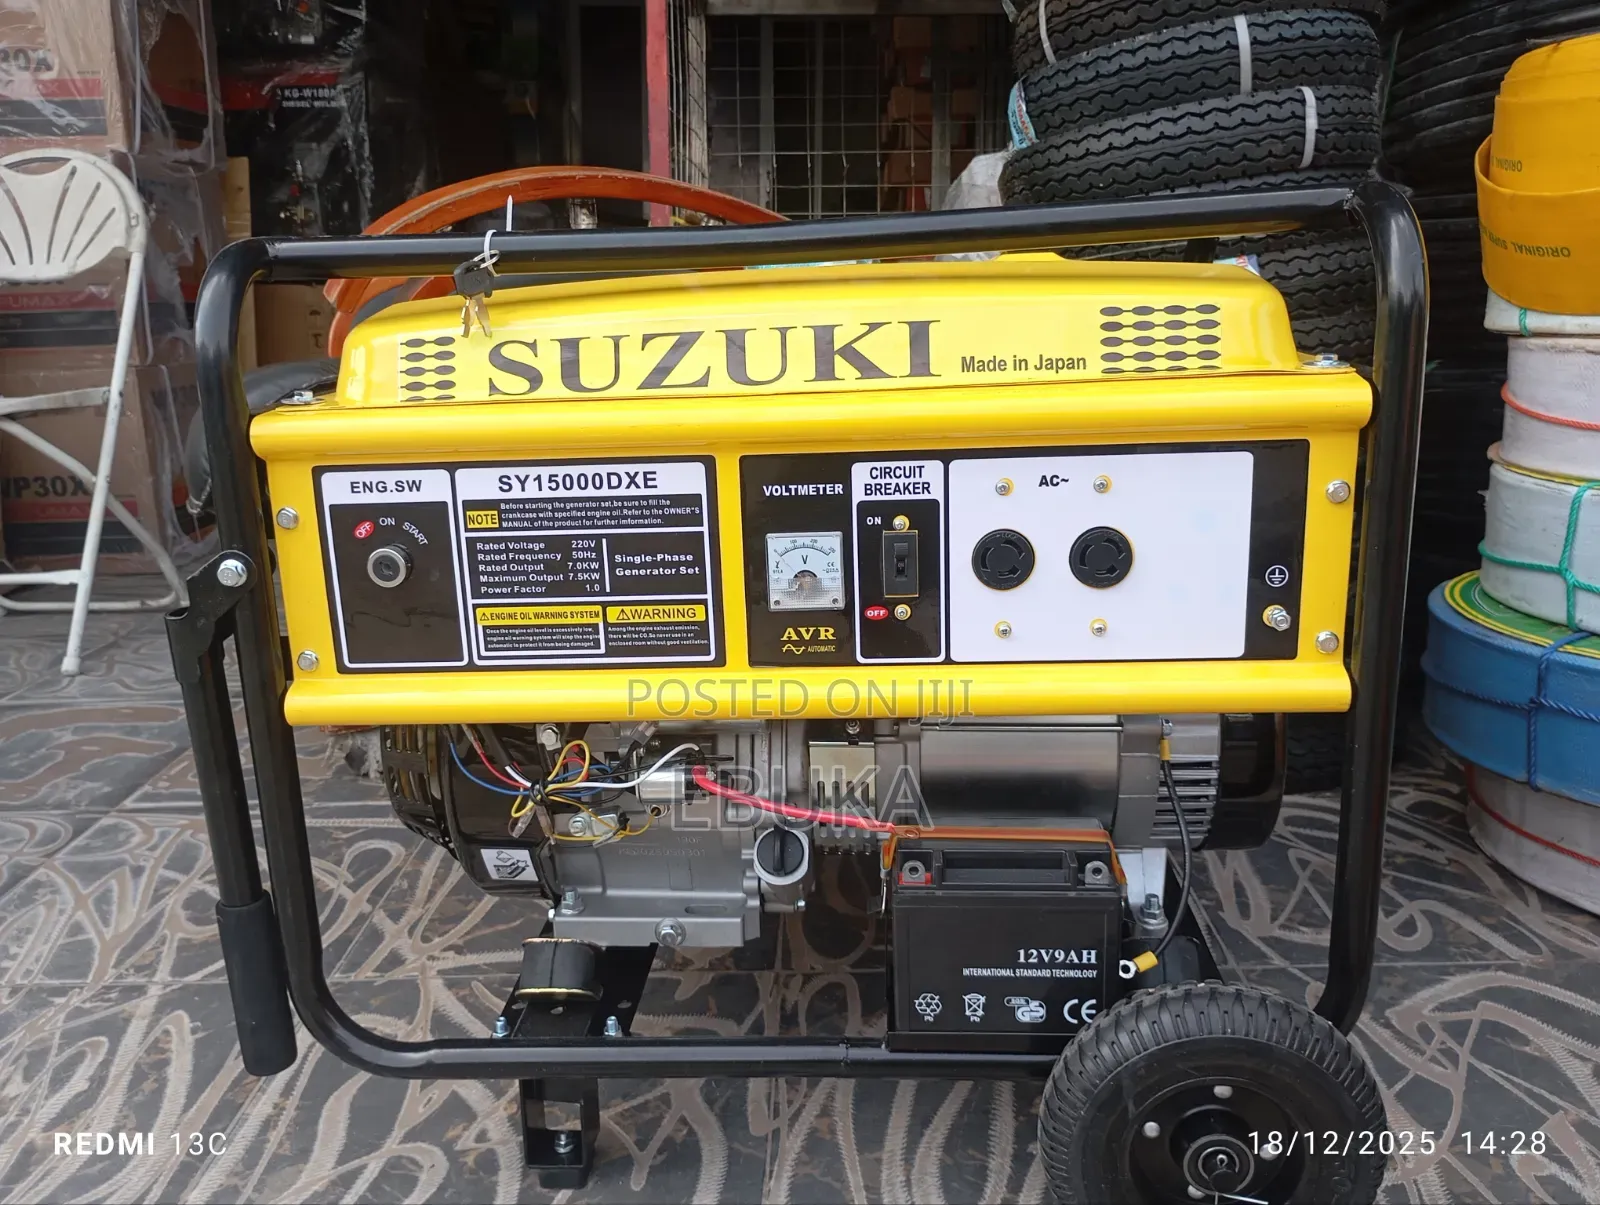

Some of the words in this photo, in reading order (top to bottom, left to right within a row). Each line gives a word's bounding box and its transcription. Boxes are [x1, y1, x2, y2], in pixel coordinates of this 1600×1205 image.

[1511, 242, 1571, 258] ORIGINAL
[488, 319, 942, 397] SUZUKI
[961, 355, 1008, 373] Made
[1012, 354, 1028, 372] in
[1034, 354, 1087, 374] Japan
[869, 465, 925, 480] CIRCUIT
[350, 480, 422, 494] ENG.SW
[498, 471, 658, 493] SY15000DXE
[763, 483, 844, 496] VOLTMETER
[864, 482, 932, 496] BREAKER
[524, 502, 552, 510] starting
[566, 501, 600, 510] generator
[468, 514, 498, 526] NOTE
[502, 510, 537, 518] crankcase
[554, 510, 586, 518] specified
[587, 510, 610, 518] engine
[379, 517, 396, 526] ON
[554, 520, 582, 528] product
[866, 516, 882, 526] ON
[356, 522, 372, 538] OFF
[402, 522, 428, 545] START
[476, 542, 506, 550] Rated
[508, 542, 546, 550] Voltage
[572, 540, 596, 548] 220V
[478, 553, 506, 561] Rated
[508, 552, 562, 562] Frequency
[572, 551, 596, 559] 50Hz
[614, 554, 694, 564] Single-Phase
[802, 554, 808, 564] V
[478, 564, 508, 572] Rated
[510, 564, 544, 572] Output
[568, 562, 600, 570] 7.0KW
[616, 568, 676, 576] Generator
[680, 566, 700, 574] Set
[480, 574, 527, 582] Maximum
[529, 574, 564, 582] Output
[490, 612, 518, 620] ENGINE
[520, 612, 532, 620] OIL
[533, 611, 568, 620] WARNING
[570, 610, 600, 620] SYSTEM
[630, 608, 696, 620] WARNING
[780, 626, 836, 641] AVR
[1016, 948, 1098, 964] 12V9AH
[962, 968, 1015, 977] INTERNATIONAL
[1015, 968, 1051, 977] STANDARD
[1052, 969, 1098, 978] TECHNOLOGY
[1063, 999, 1097, 1024] CE
